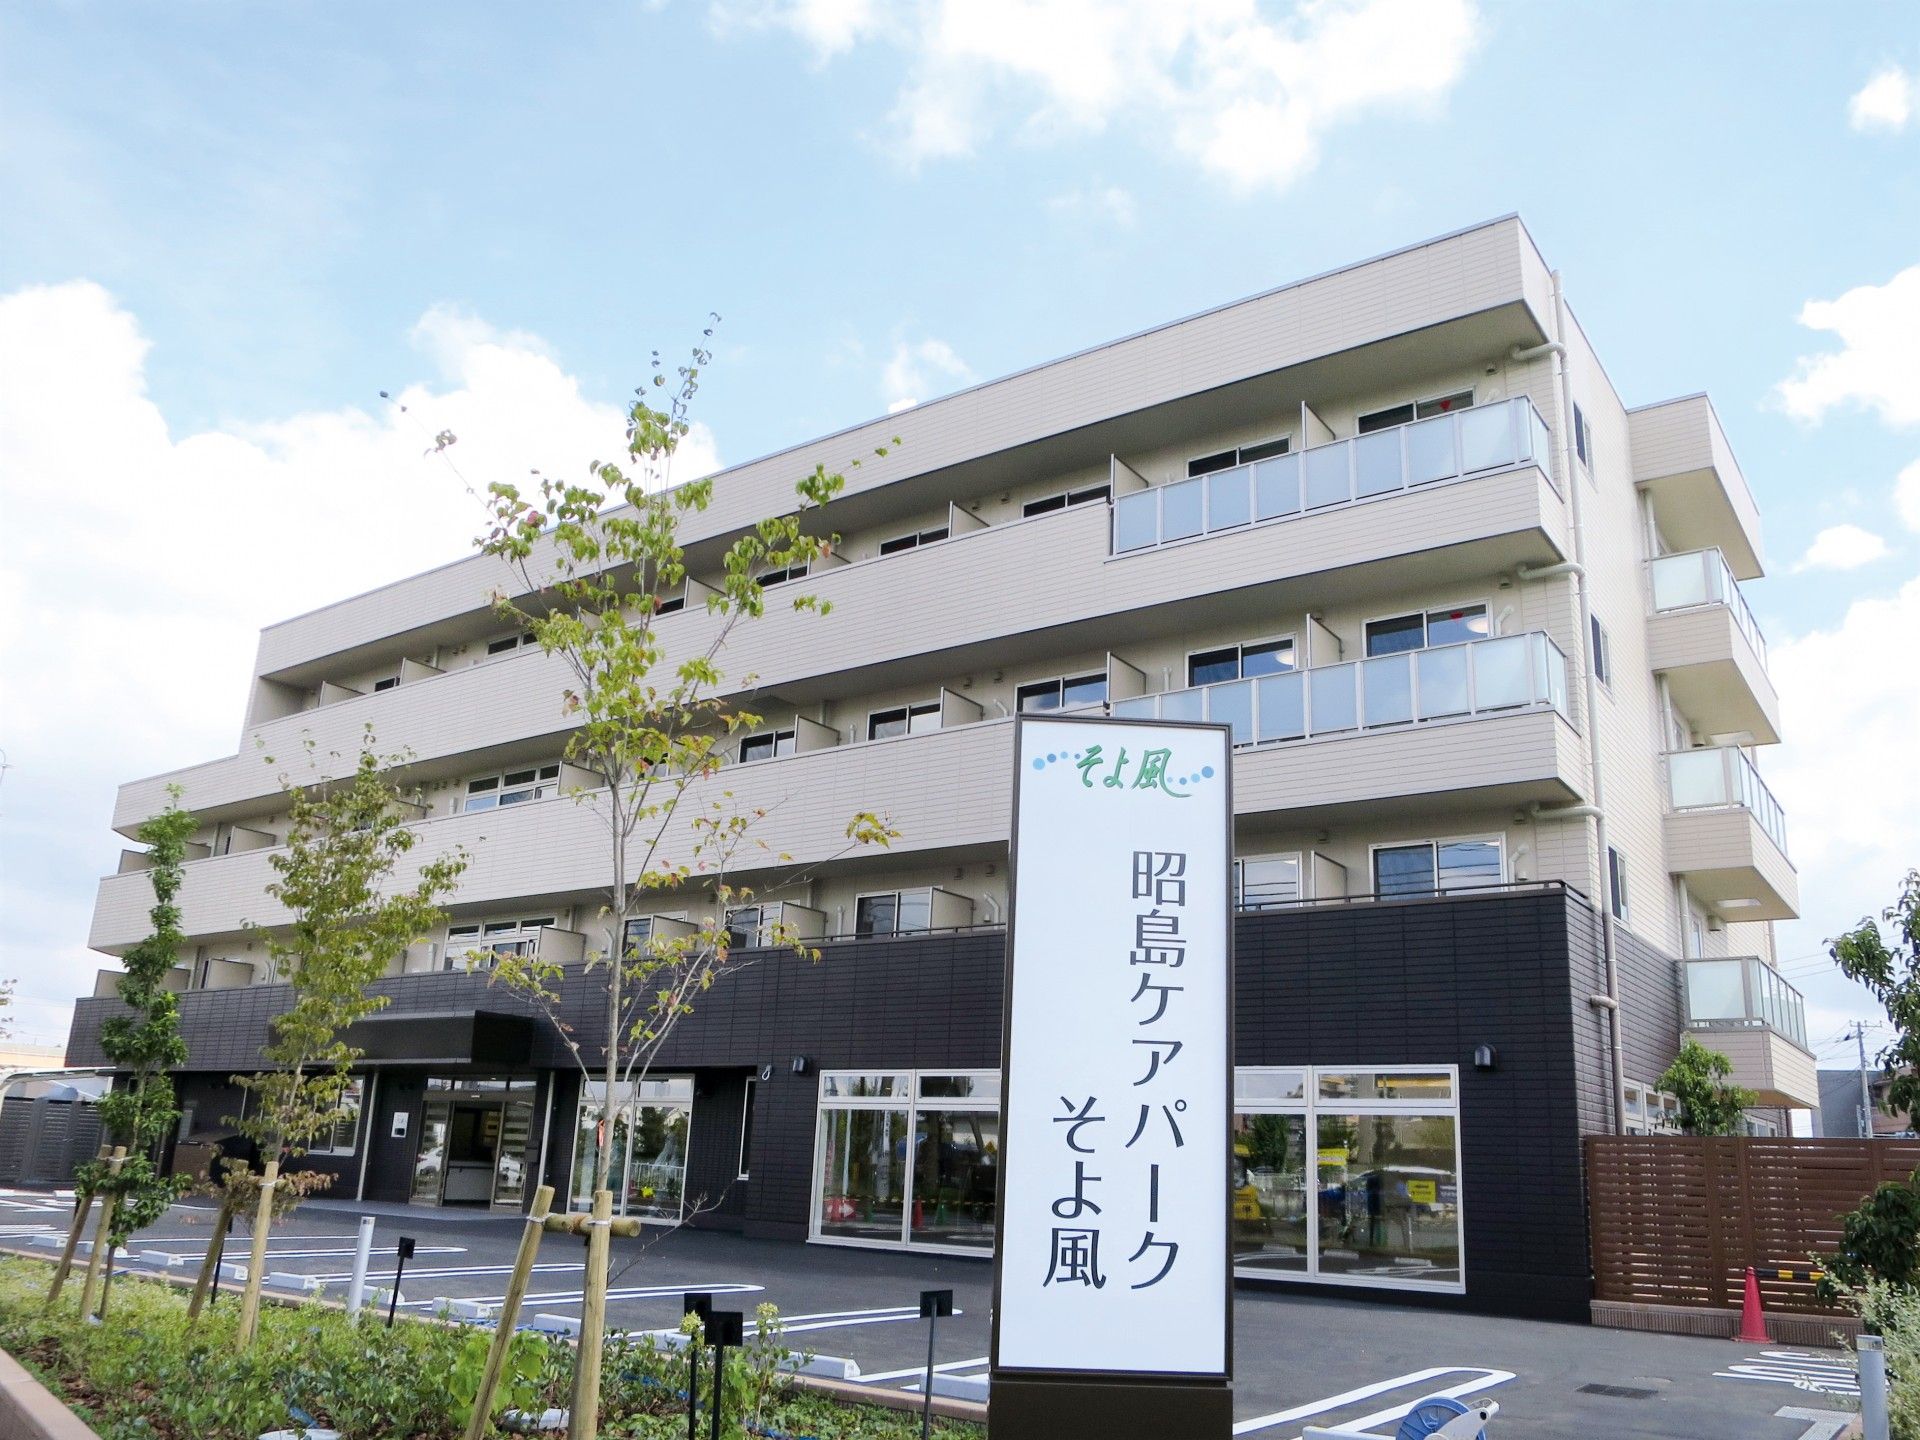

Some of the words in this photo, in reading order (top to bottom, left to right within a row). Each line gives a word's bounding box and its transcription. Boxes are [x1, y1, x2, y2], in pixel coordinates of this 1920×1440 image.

[1076, 744, 1192, 798] そよ風
[1125, 851, 1188, 1290] 昭島ケアパーク
[1042, 1095, 1107, 1290] そよ風
